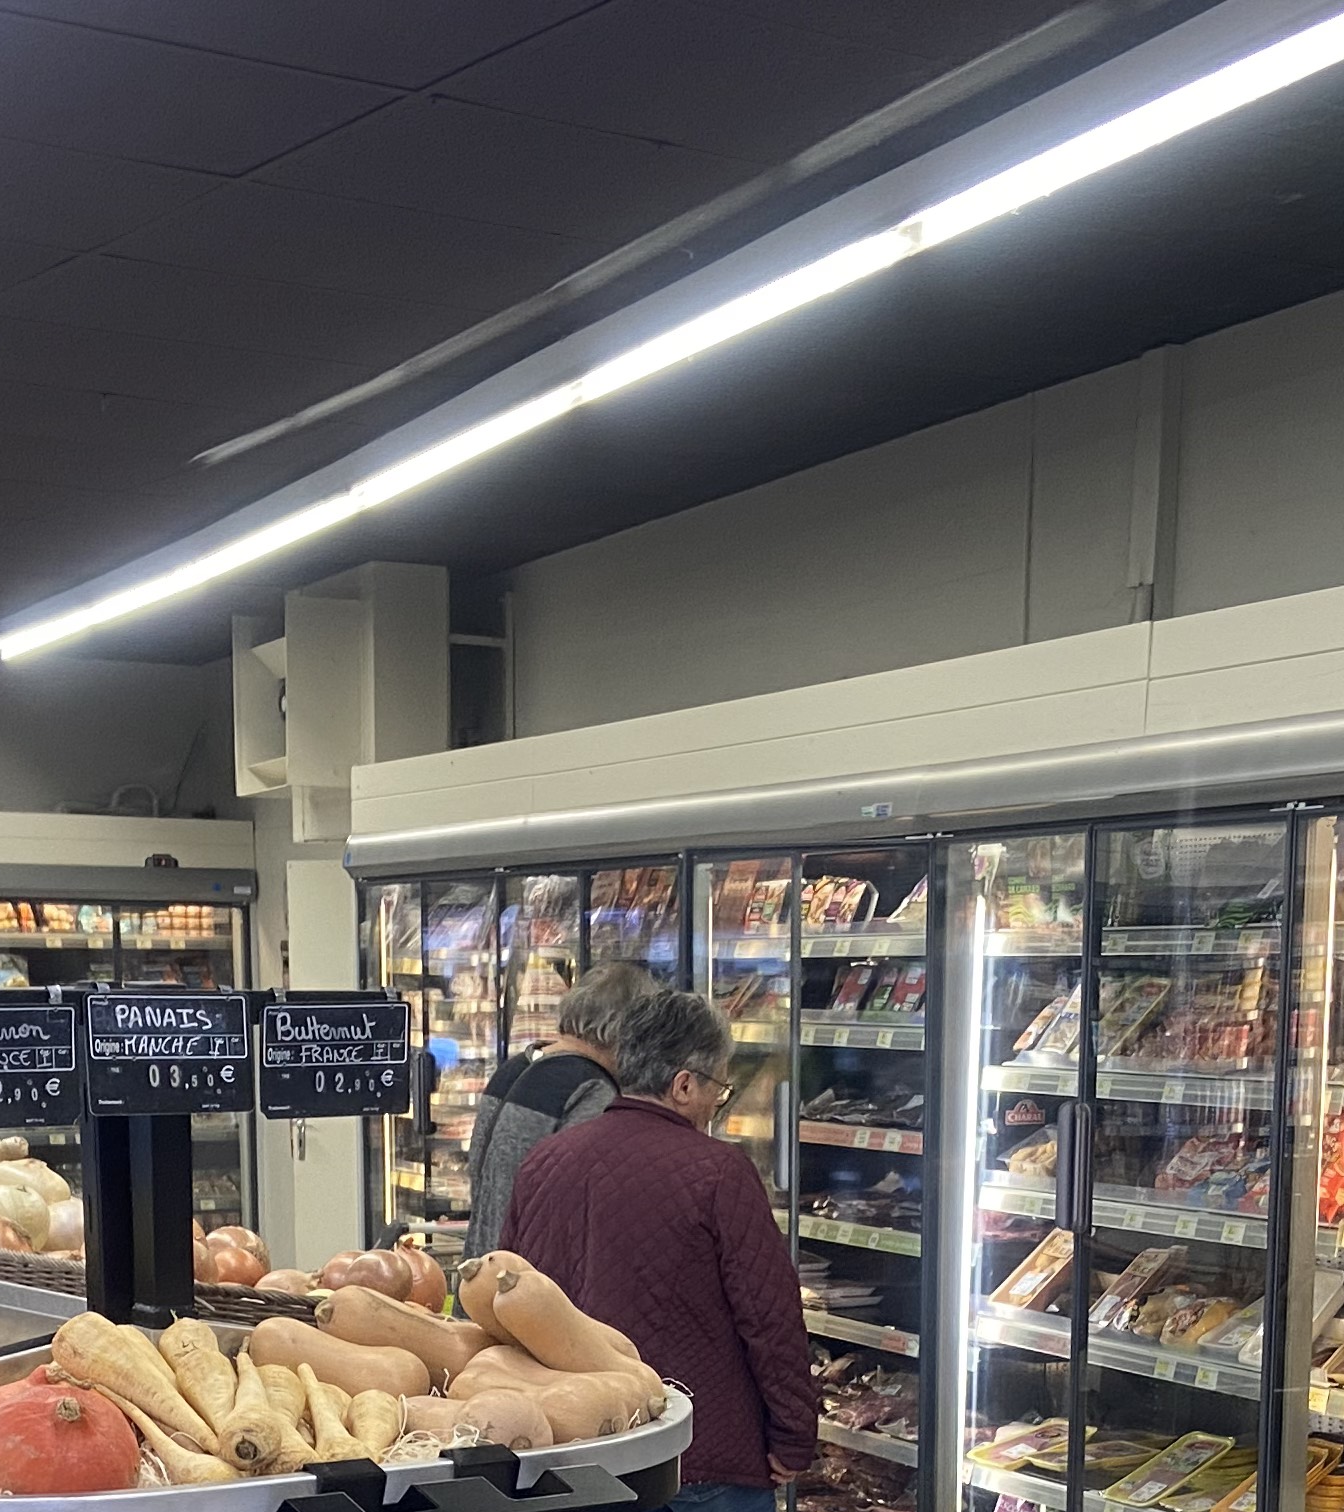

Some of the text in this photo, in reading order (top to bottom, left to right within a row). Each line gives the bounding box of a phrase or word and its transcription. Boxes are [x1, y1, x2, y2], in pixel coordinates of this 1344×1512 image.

[115, 1004, 212, 1030] PANAIS
[276, 1011, 376, 1042] Butternut
[125, 1035, 201, 1057] MANCHE
[299, 1045, 364, 1063] FRANCE
